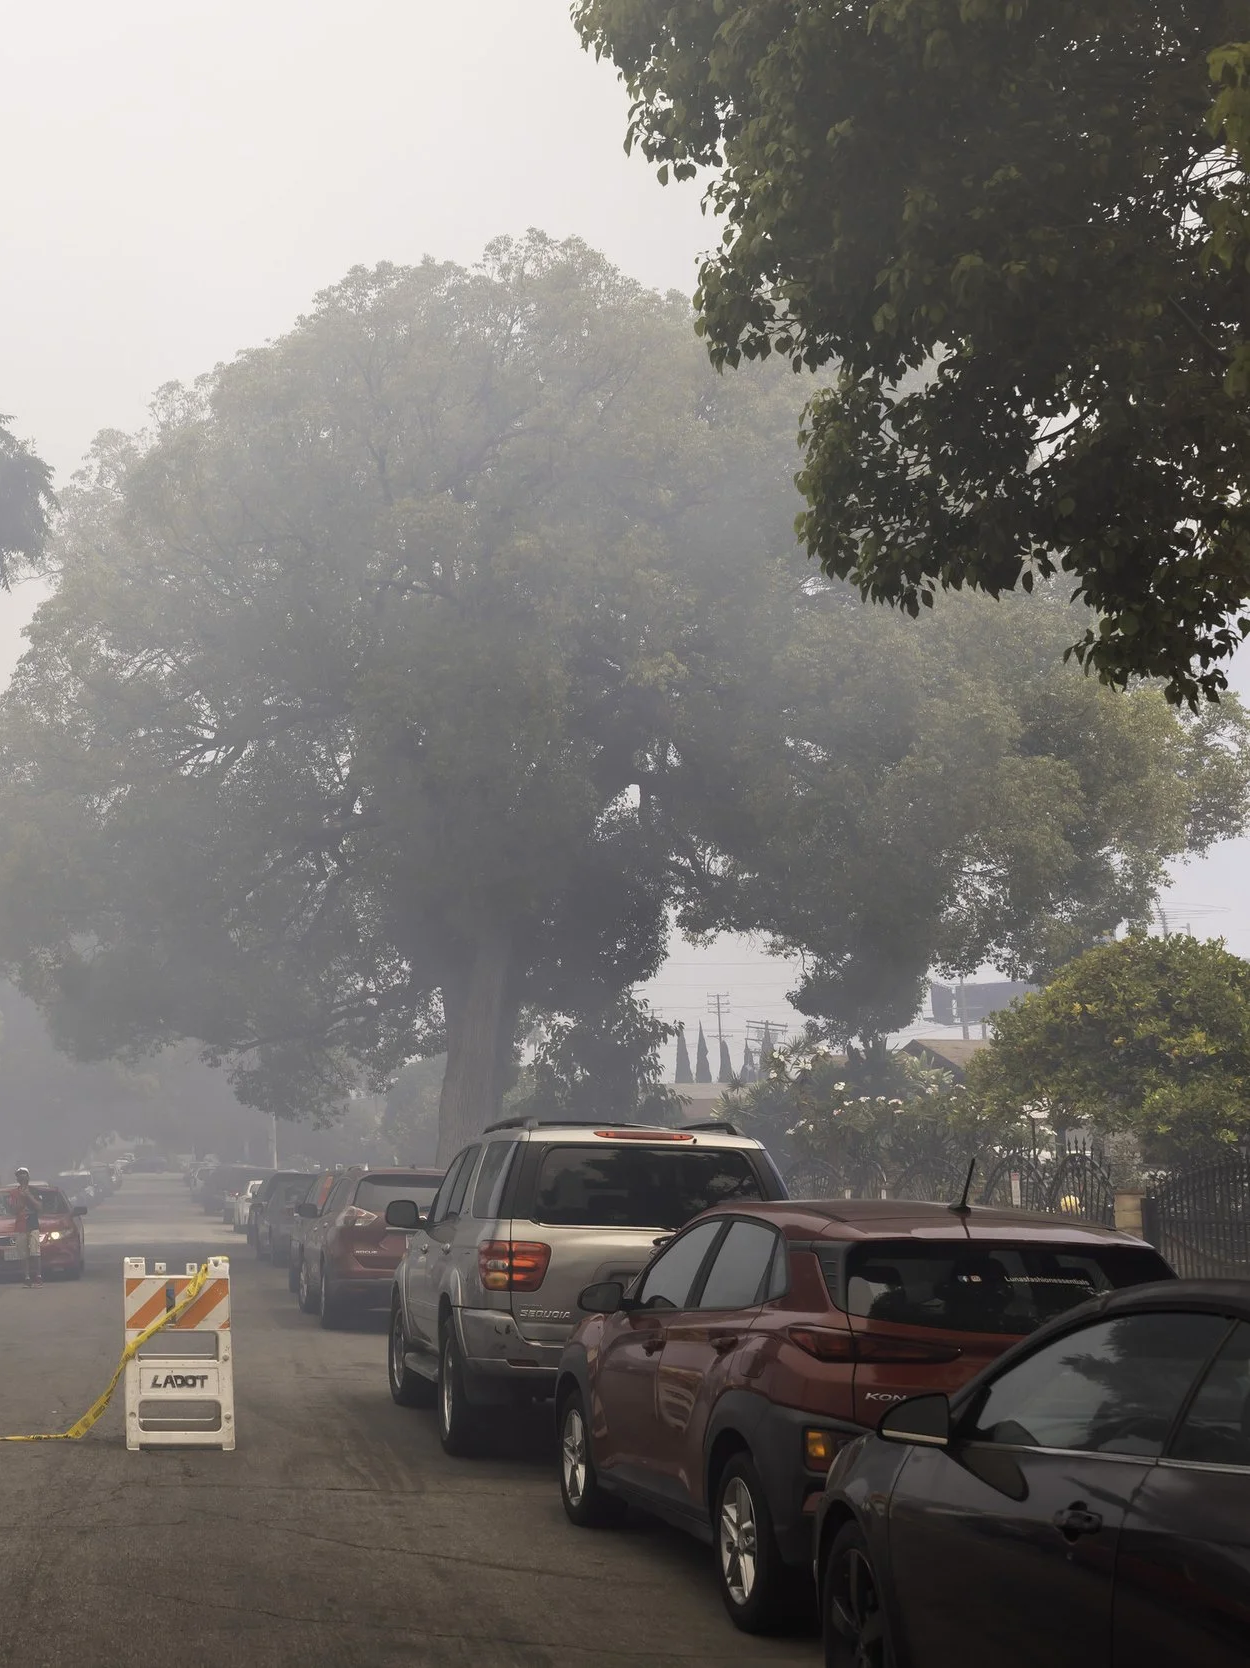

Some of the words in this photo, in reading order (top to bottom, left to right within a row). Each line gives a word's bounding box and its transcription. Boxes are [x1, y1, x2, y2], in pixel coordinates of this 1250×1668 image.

[520, 1309, 571, 1319] SEQUOIA
[150, 1374, 208, 1389] LADOT
[865, 1392, 907, 1401] KON
